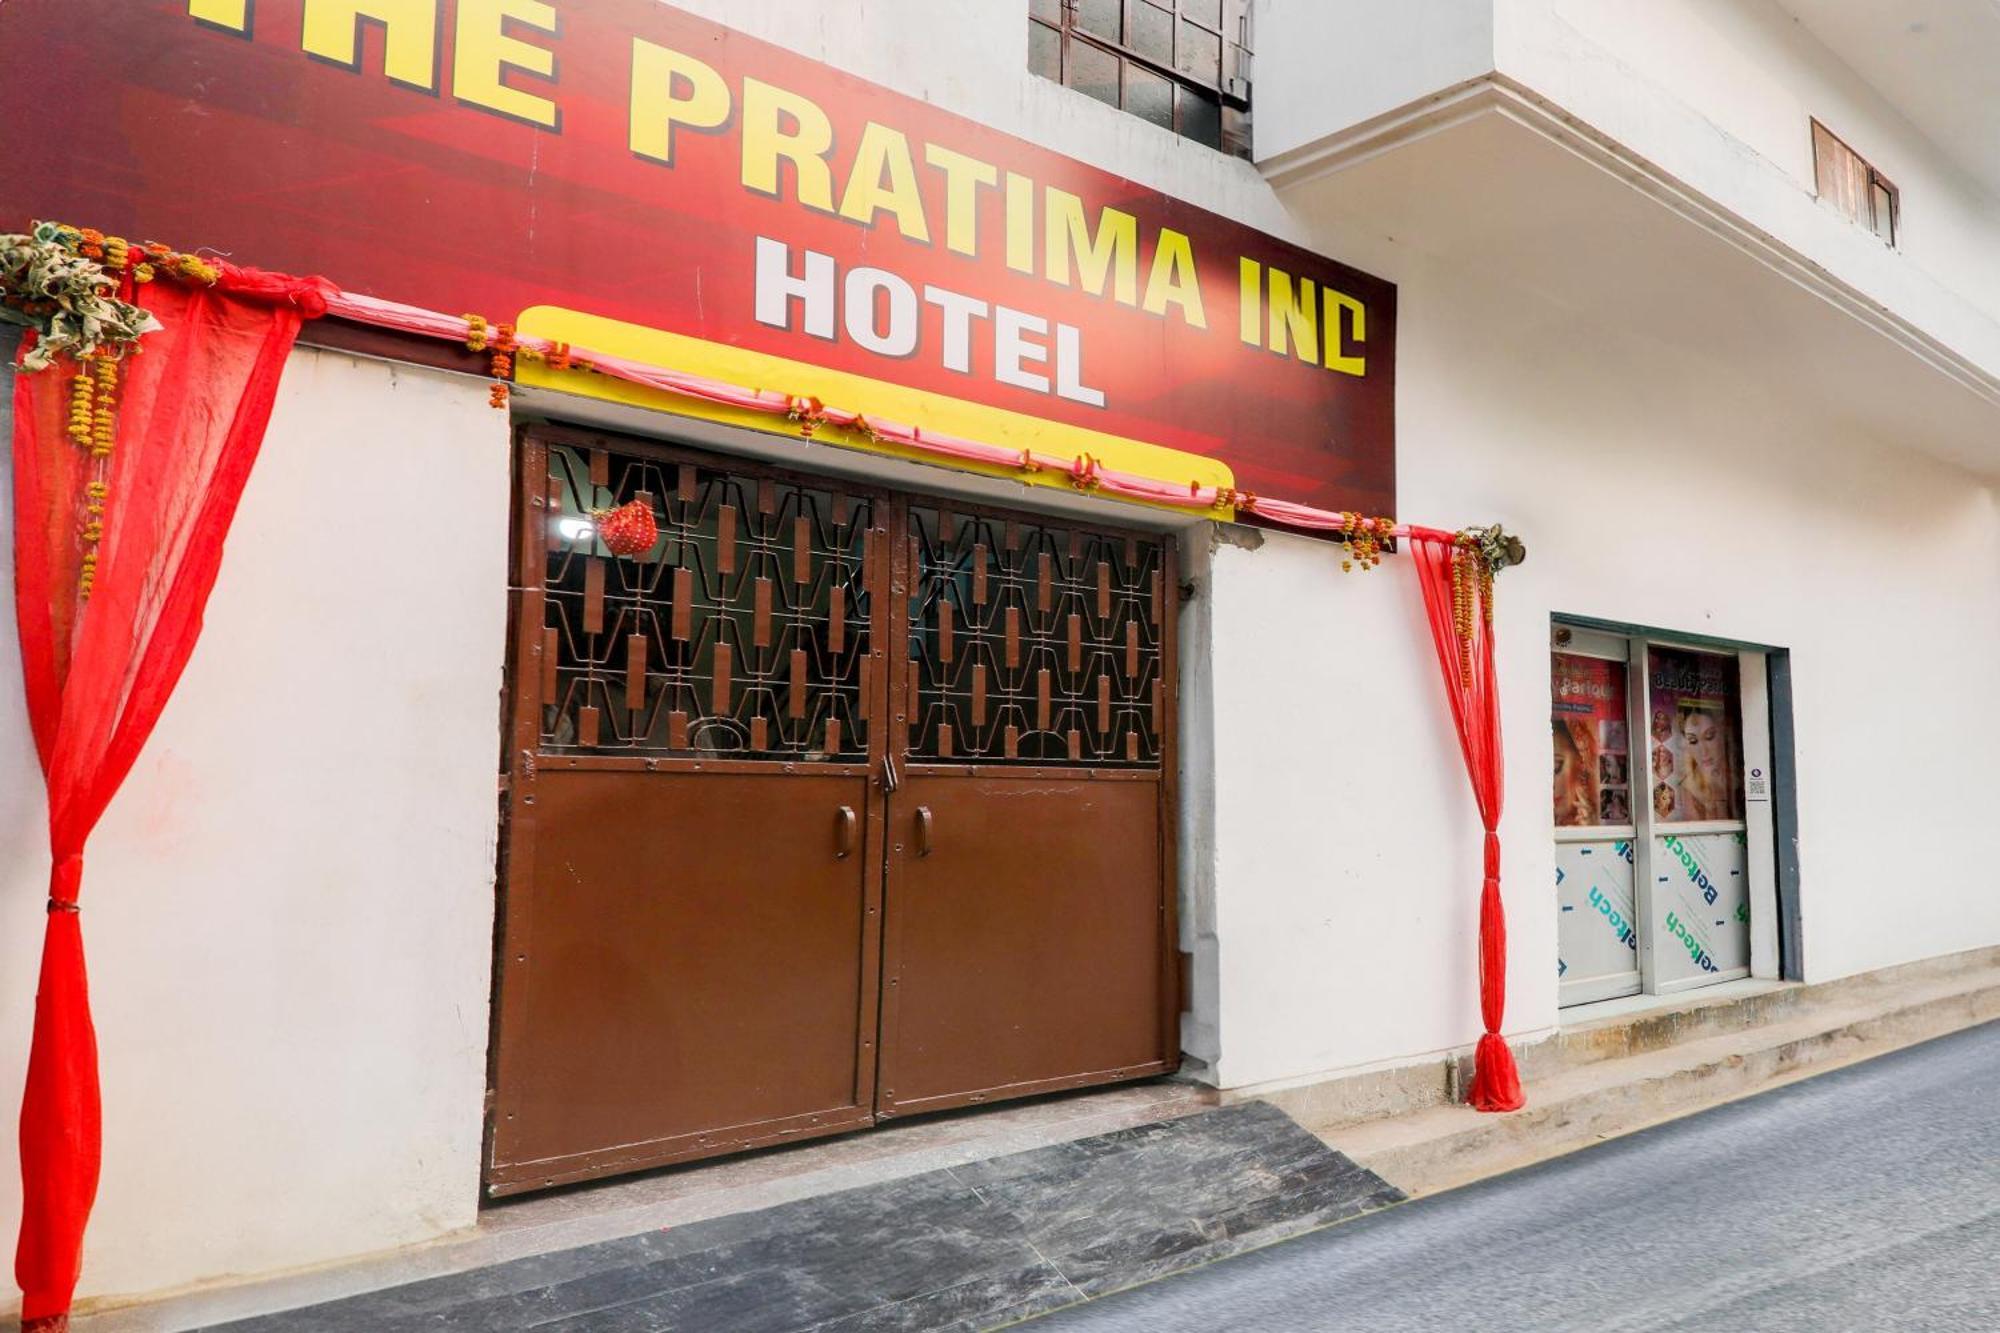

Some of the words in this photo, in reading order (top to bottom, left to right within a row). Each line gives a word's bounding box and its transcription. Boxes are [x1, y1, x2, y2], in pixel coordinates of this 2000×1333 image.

[189, 0, 560, 134] HE
[628, 36, 1207, 329] PRATIMA
[1239, 255, 1366, 378] INC
[754, 235, 1106, 407] HOTEL
[1588, 885, 1637, 950] eltech
